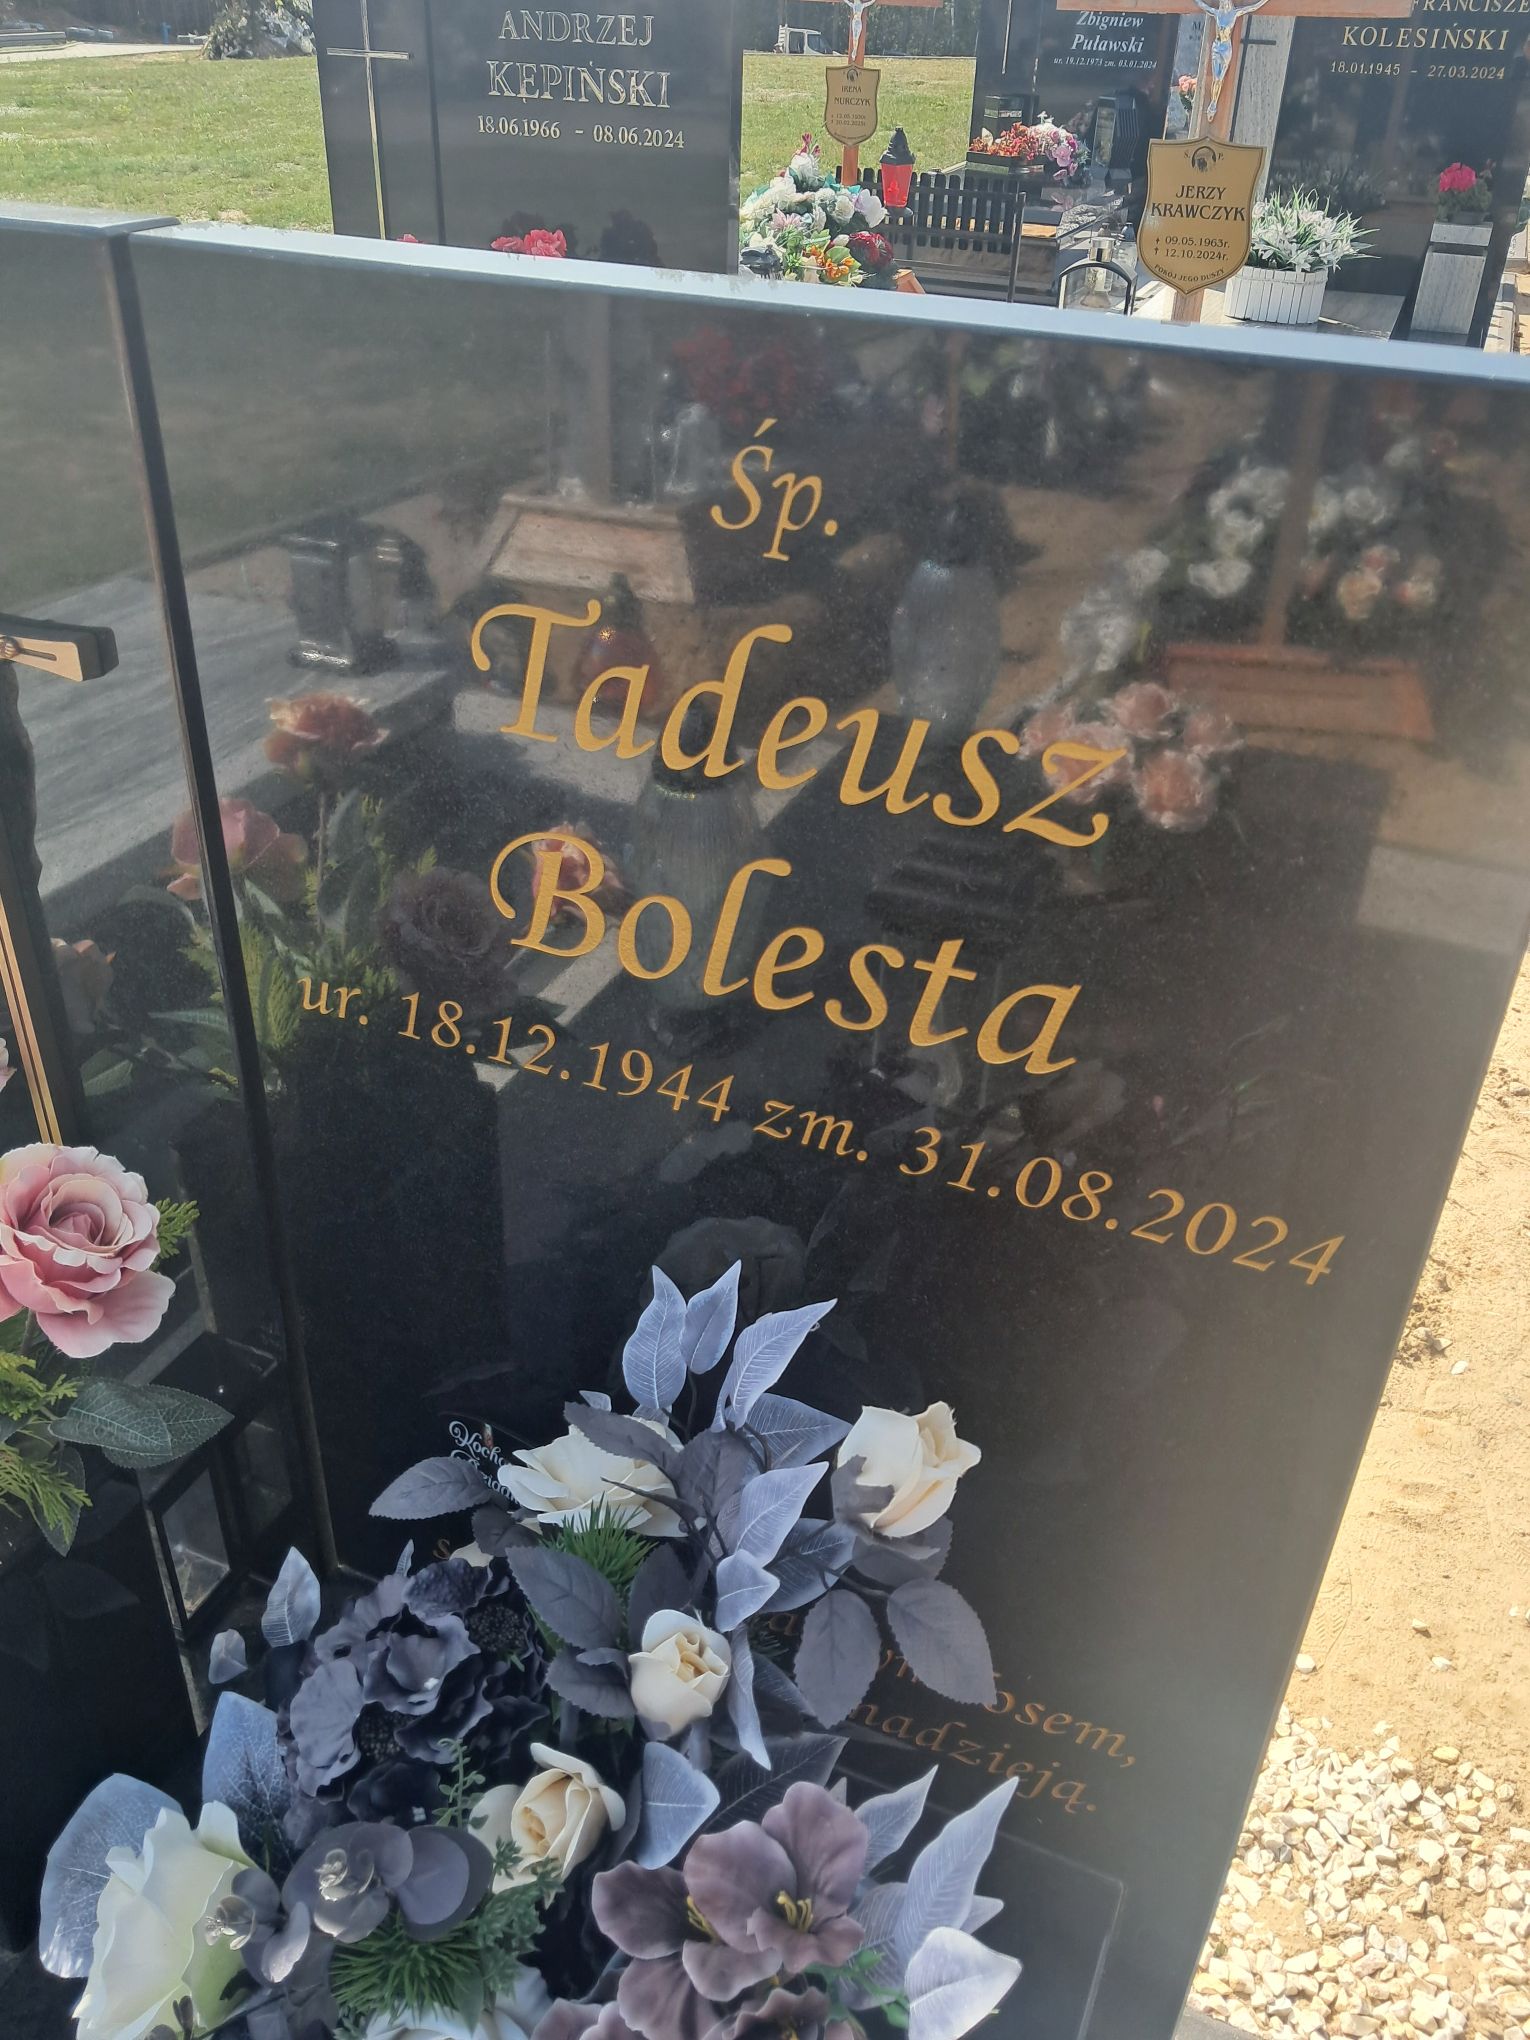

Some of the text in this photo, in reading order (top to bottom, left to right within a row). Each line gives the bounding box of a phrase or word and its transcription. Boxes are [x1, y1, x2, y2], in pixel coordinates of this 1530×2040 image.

[499, 9, 655, 47] ANDRZEJ
[1076, 11, 1144, 30] Zbigniew
[1070, 33, 1145, 53] Puławski
[1342, 22, 1510, 51] KOLESIŃSKI
[486, 60, 671, 109] KĘPIŃSKI
[1329, 61, 1401, 76] 18.01.1945
[1427, 64, 1506, 80] 27.03.2024
[477, 115, 561, 139] 18.06.1966
[593, 124, 685, 149] 08.06.2024
[1176, 185, 1227, 200] JERZY
[1150, 202, 1246, 221] KRAWCZYK
[1165, 248, 1229, 261] 12.10.2024r.
[710, 418, 839, 562] Śp.
[471, 598, 1127, 848] Tadeusz
[489, 831, 1083, 1075] Bolesta
[296, 974, 1346, 1287] ur. 18.12.1944 zm. 31.08.2024
